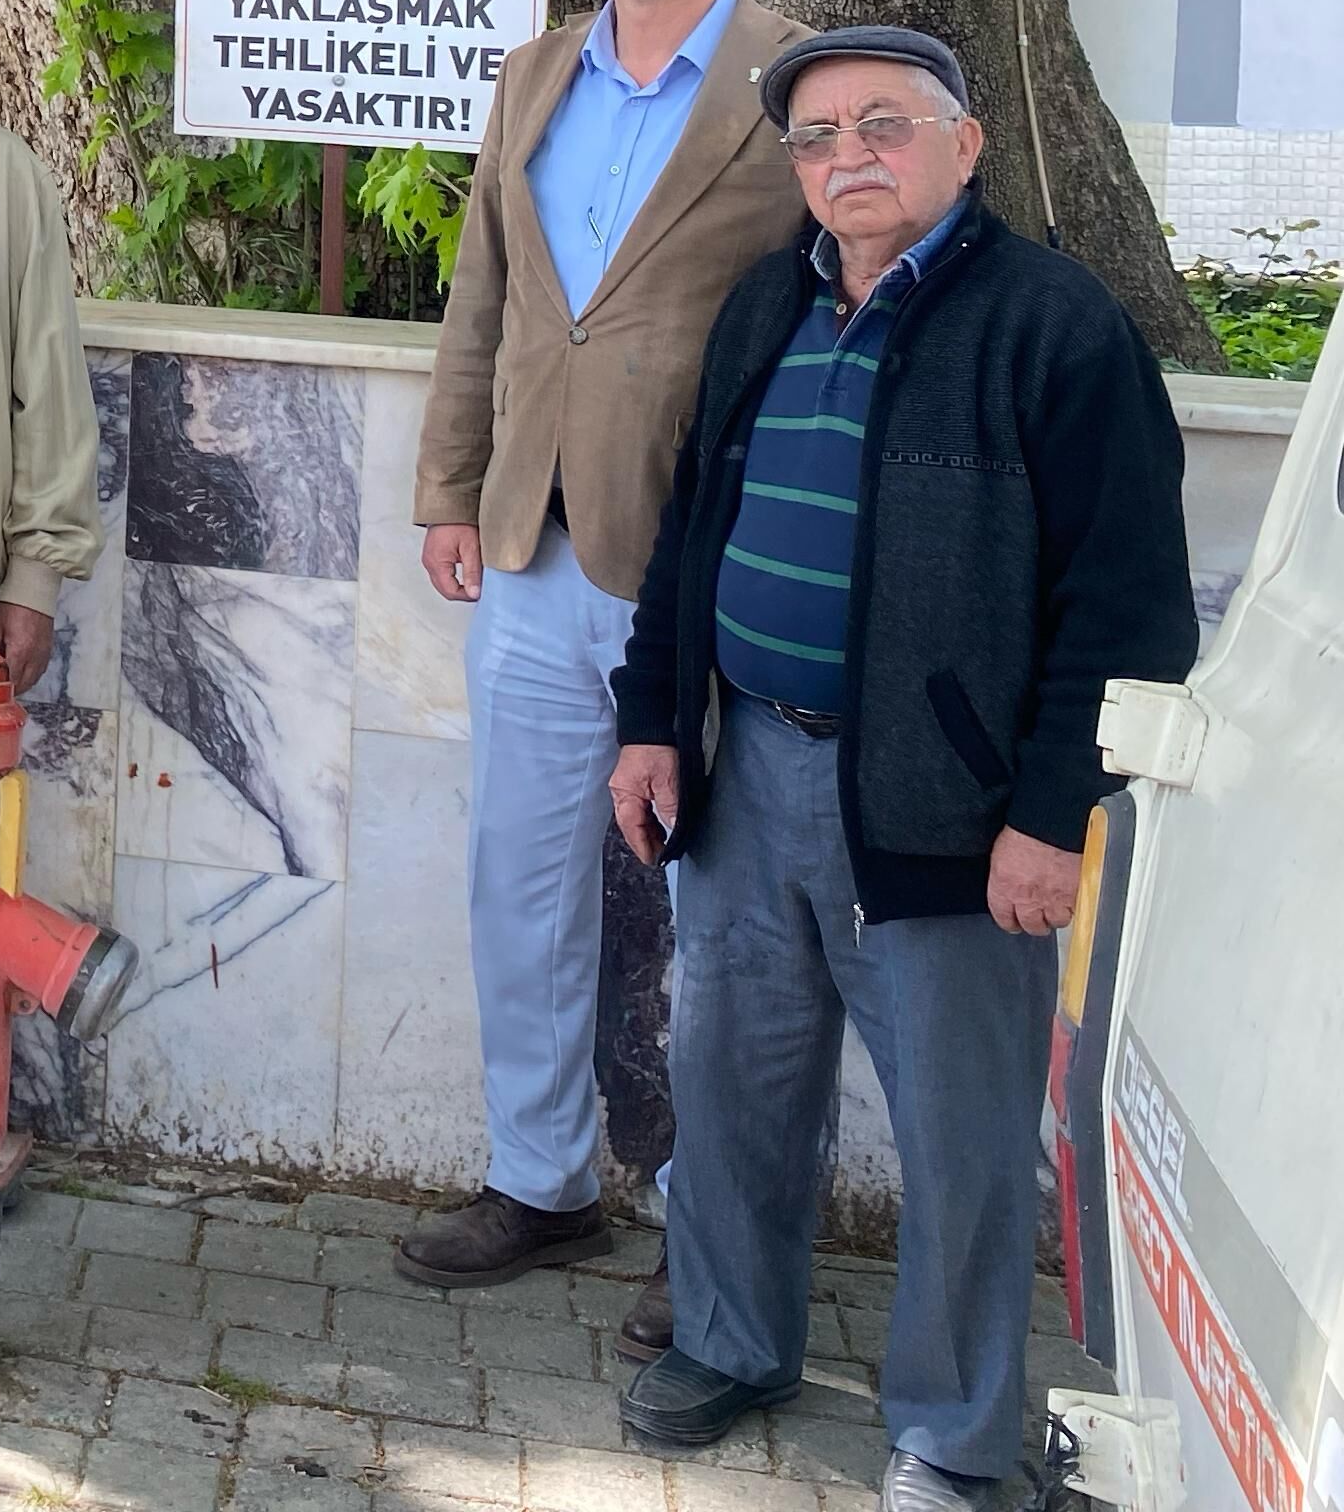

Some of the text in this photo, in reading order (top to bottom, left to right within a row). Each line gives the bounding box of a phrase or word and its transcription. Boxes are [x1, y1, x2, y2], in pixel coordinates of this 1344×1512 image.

[213, 30, 505, 81] TEHLİKELİ VE
[242, 85, 472, 132] YASAKTIR!
